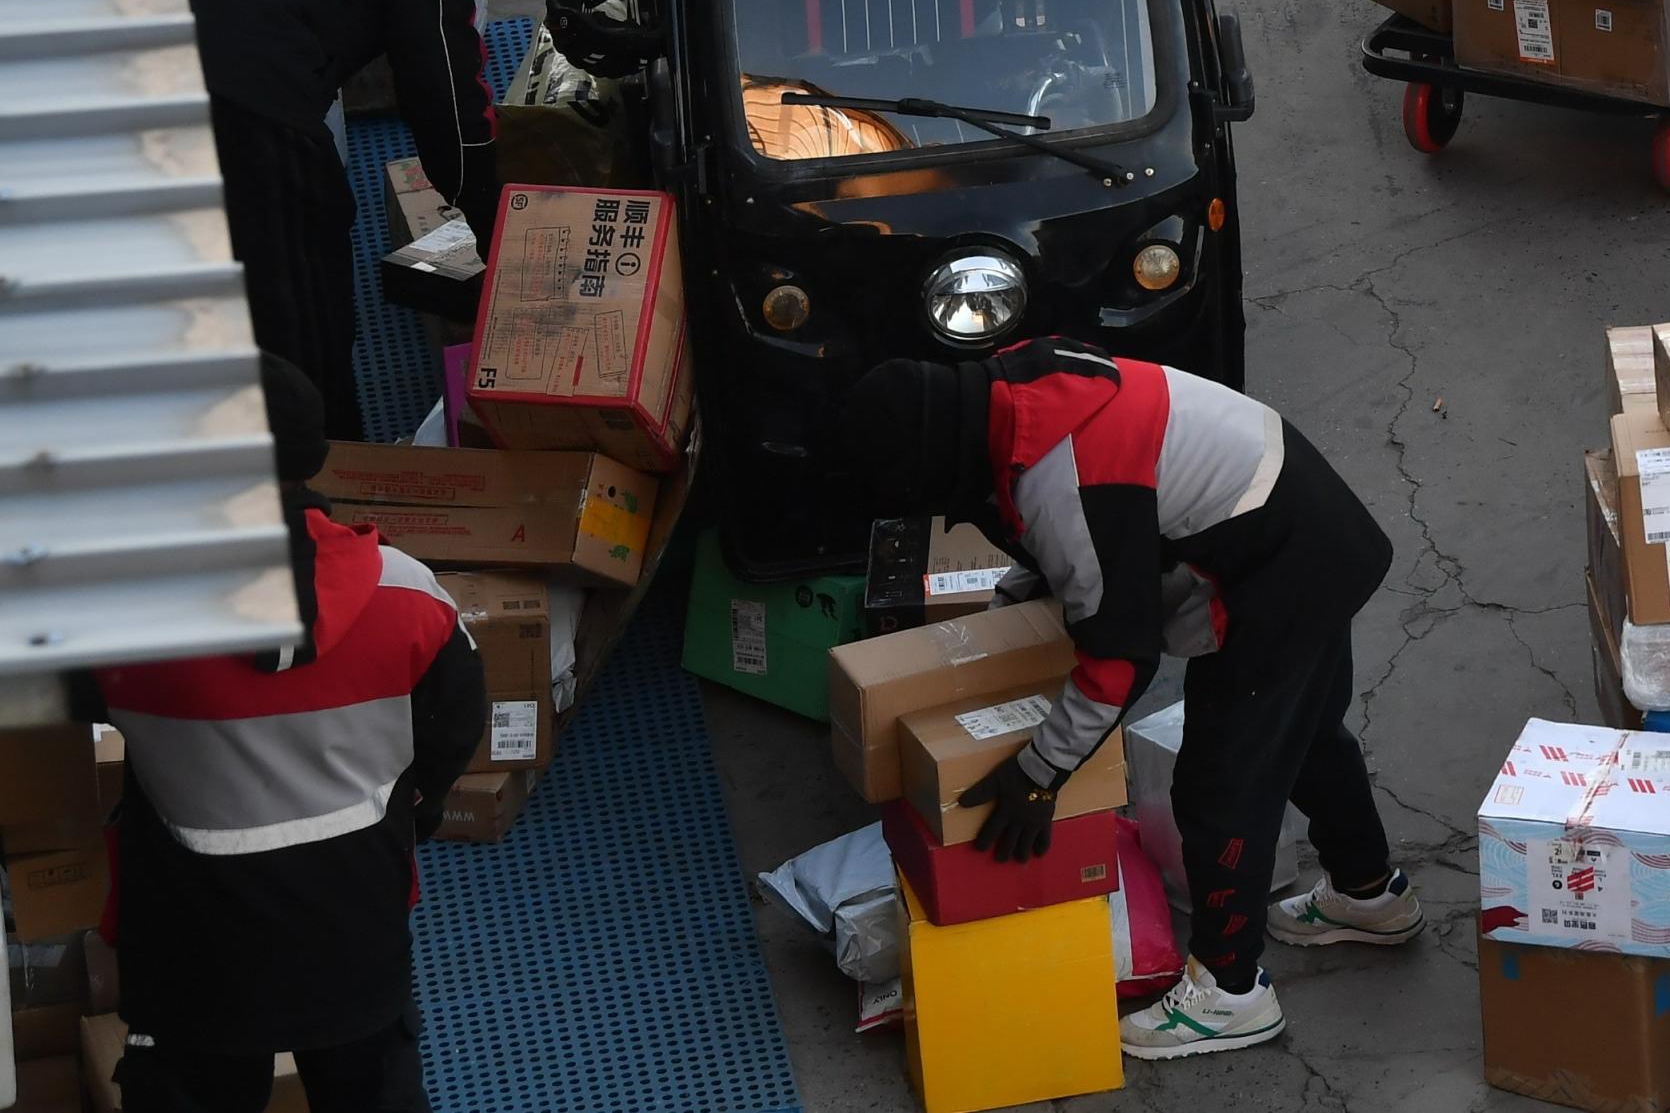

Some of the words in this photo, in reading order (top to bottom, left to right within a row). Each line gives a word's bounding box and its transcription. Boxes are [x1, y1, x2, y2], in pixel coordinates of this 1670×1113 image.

[620, 199, 651, 248] 顺丰
[579, 198, 621, 298] 服务指南
[478, 367, 498, 389] F5
[873, 989, 898, 1005] ONLY
